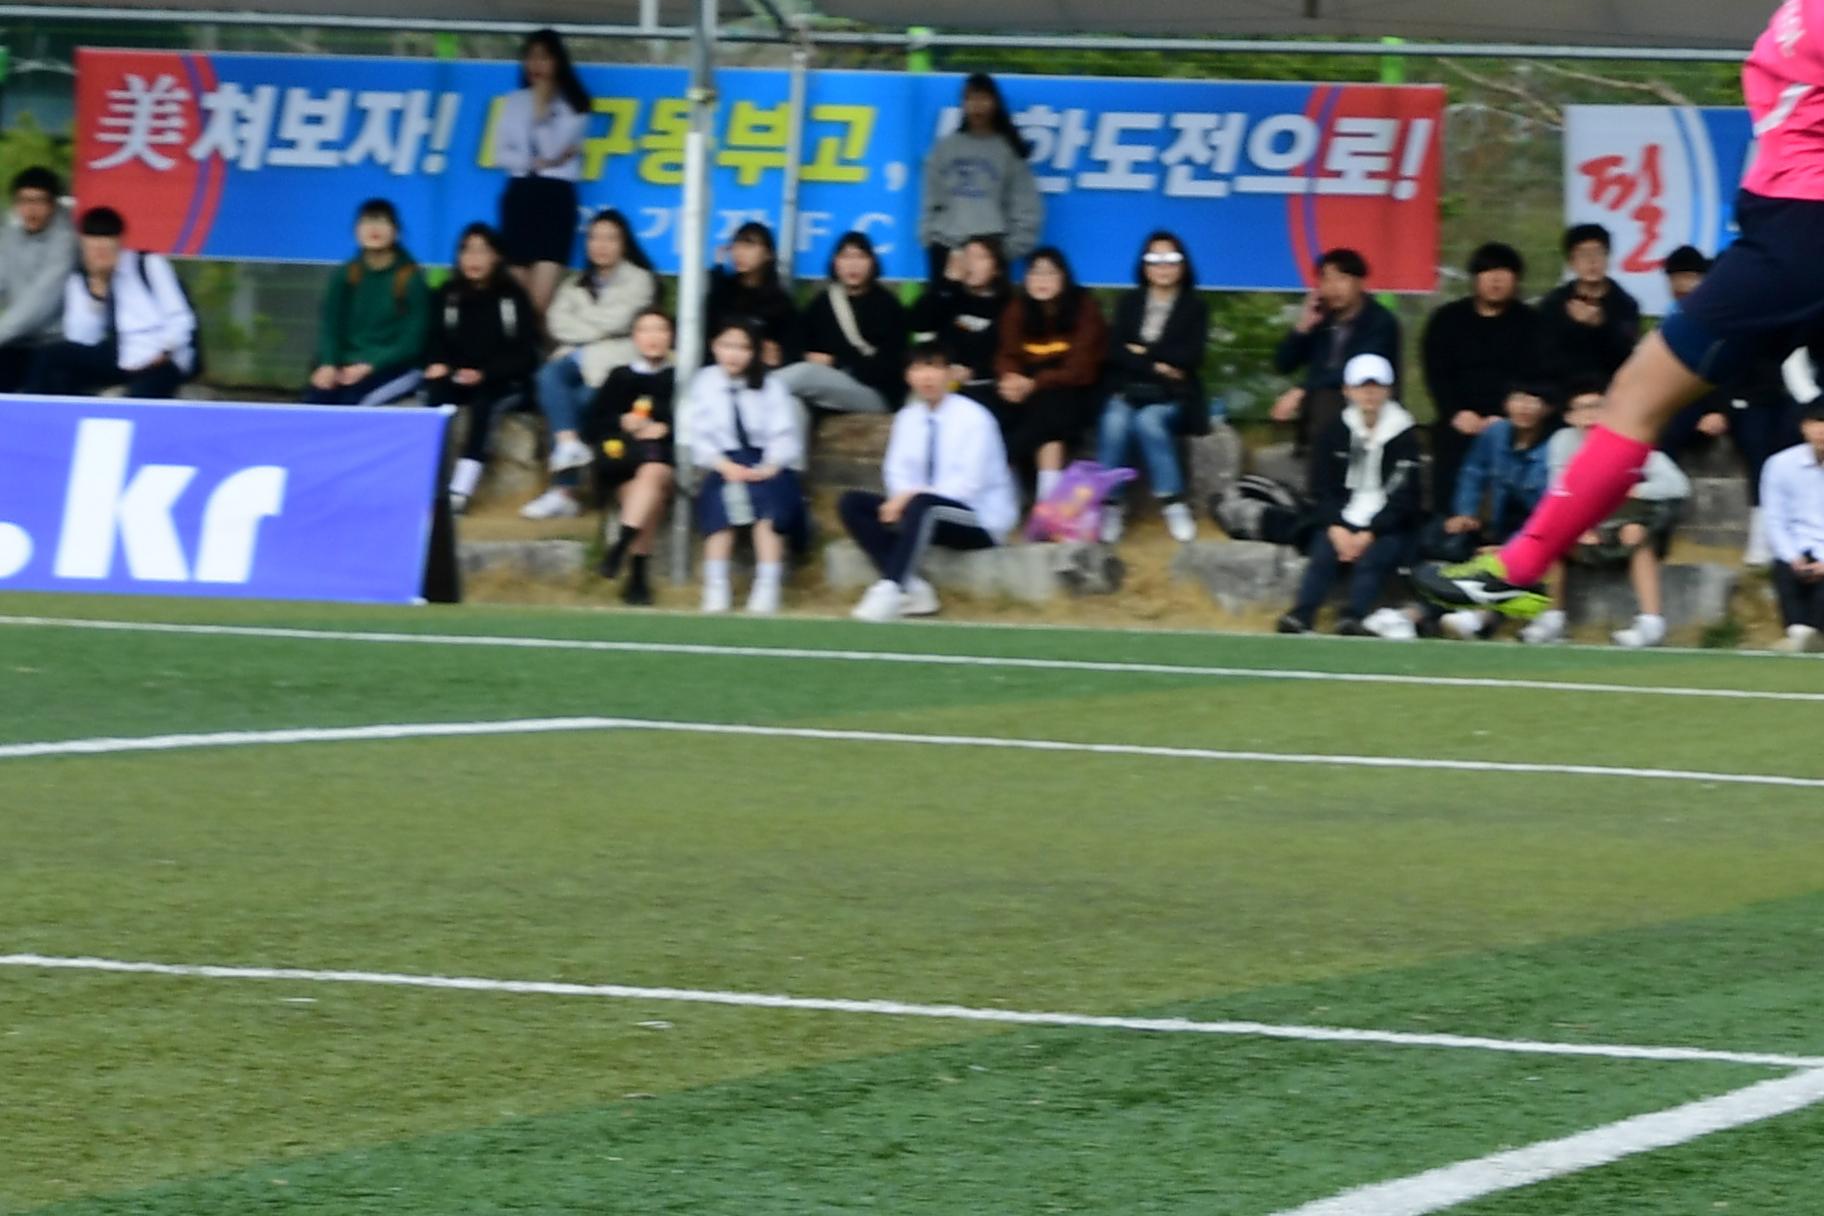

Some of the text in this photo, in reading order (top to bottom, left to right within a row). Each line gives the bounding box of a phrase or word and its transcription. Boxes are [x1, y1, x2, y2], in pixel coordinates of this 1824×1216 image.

[88, 74, 462, 175] 美쳐보자!
[478, 95, 908, 192] 구동부고,
[932, 104, 1435, 201] 한도전으로!
